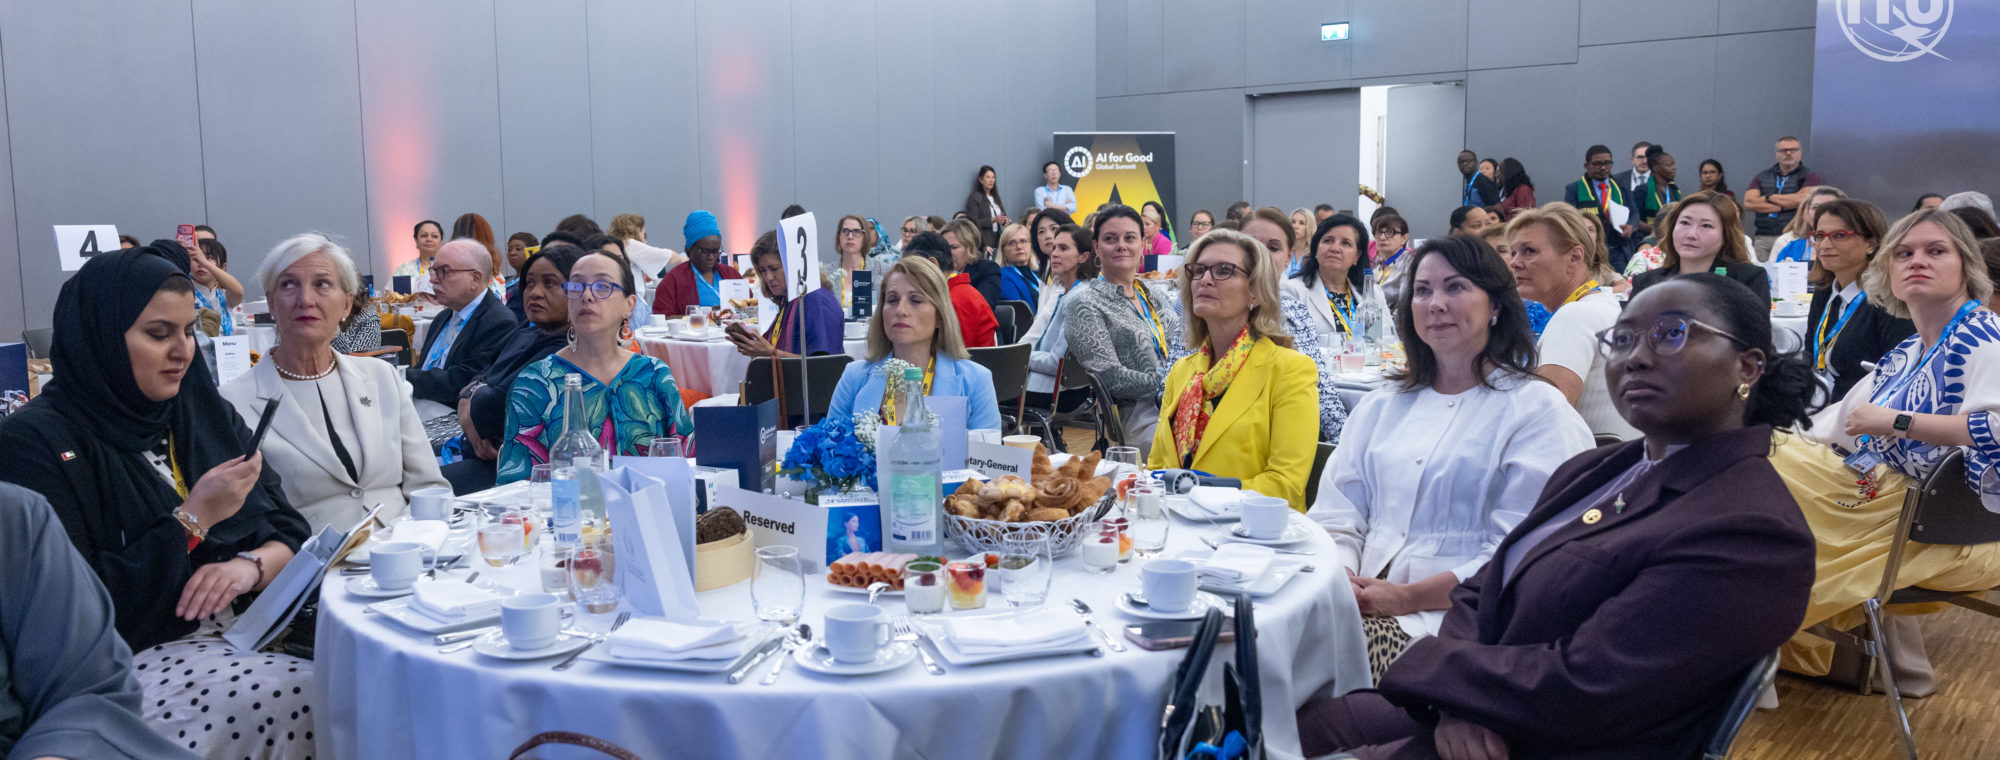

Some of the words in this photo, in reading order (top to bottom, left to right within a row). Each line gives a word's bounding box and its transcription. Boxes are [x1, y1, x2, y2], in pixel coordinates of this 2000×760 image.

[1071, 156, 1087, 168] AI
[1095, 153, 1107, 162] AI
[1109, 152, 1124, 162] for
[1125, 152, 1153, 162] Good
[79, 230, 103, 257] 4
[797, 226, 808, 286] 3
[967, 456, 1018, 473] tary-General
[743, 510, 795, 535] Reserved
